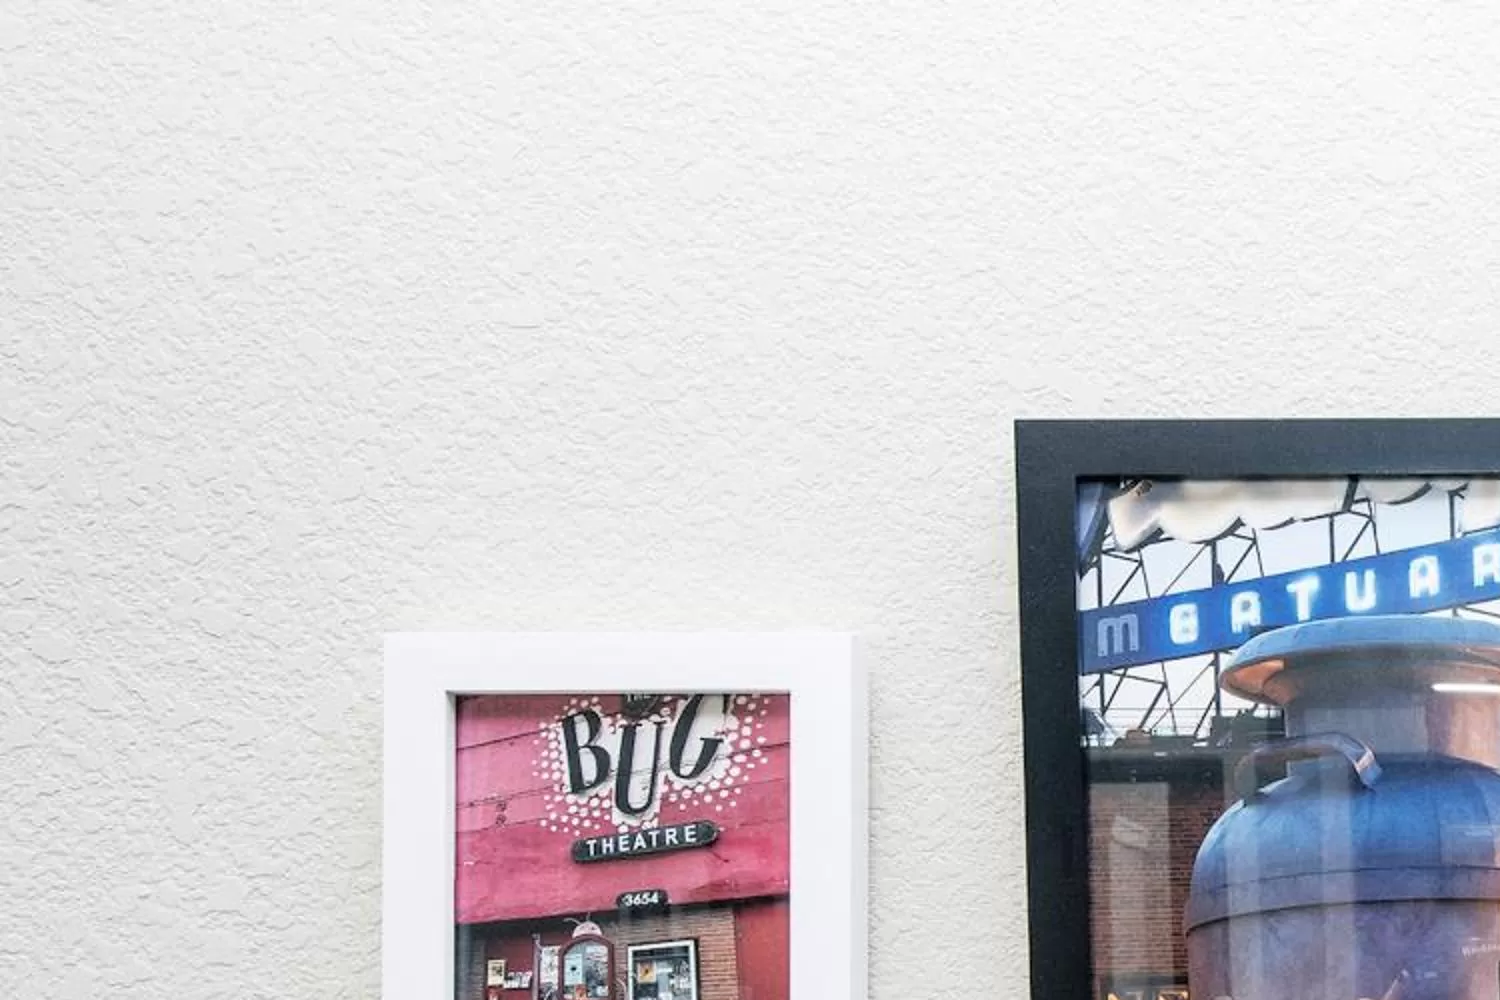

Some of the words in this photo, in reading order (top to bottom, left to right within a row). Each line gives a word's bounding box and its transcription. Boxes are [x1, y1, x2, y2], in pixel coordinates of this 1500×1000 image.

[560, 693, 729, 815] BUG
[587, 825, 698, 857] THEATRE
[622, 891, 659, 907] 3654
